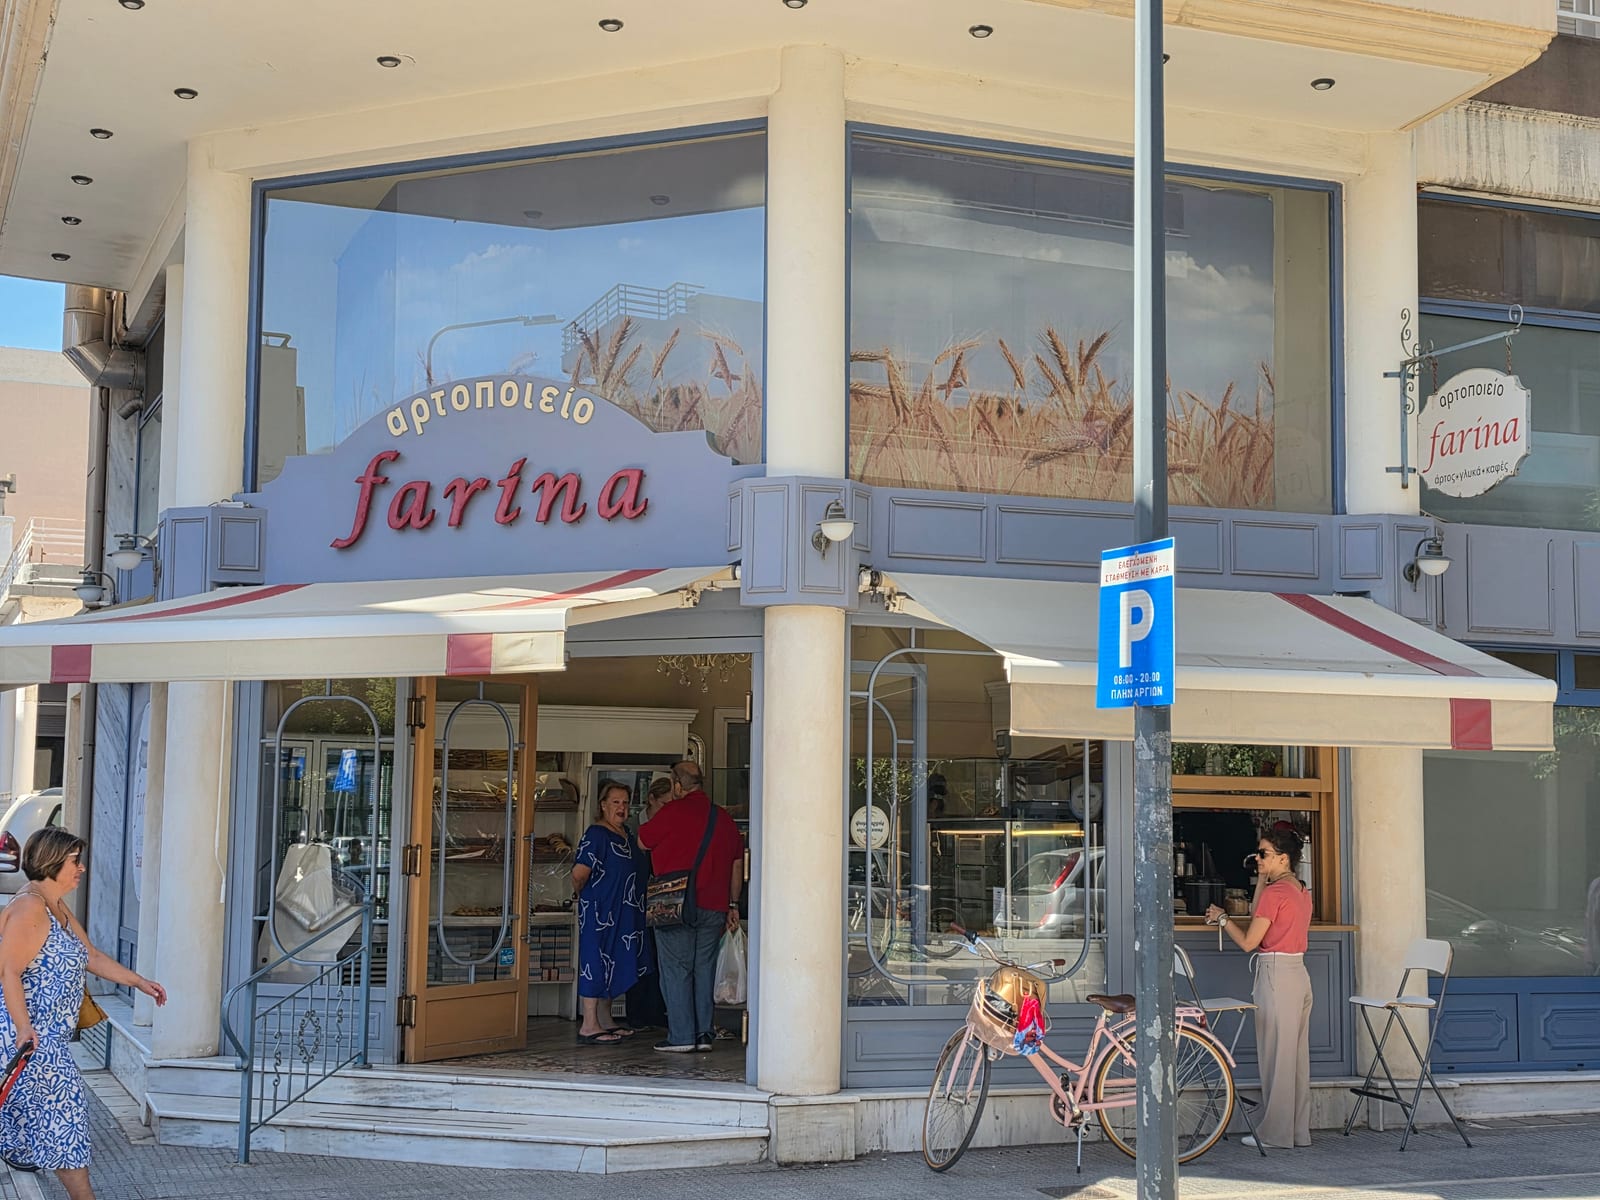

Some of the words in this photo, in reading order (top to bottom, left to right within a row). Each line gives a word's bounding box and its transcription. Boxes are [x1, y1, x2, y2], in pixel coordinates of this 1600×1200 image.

[1440, 378, 1504, 409] αρτοποιείο
[386, 380, 595, 437] αρτοποιείο
[1150, 564, 1170, 576] ΚΑΡΤΑ
[1119, 589, 1154, 668] P
[1113, 674, 1134, 685] 08:00
[1140, 672, 1160, 683] 20:00
[1111, 688, 1133, 700] ΠΛΗΝ
[1134, 685, 1163, 698] ΑΡΓΙΩΝ
